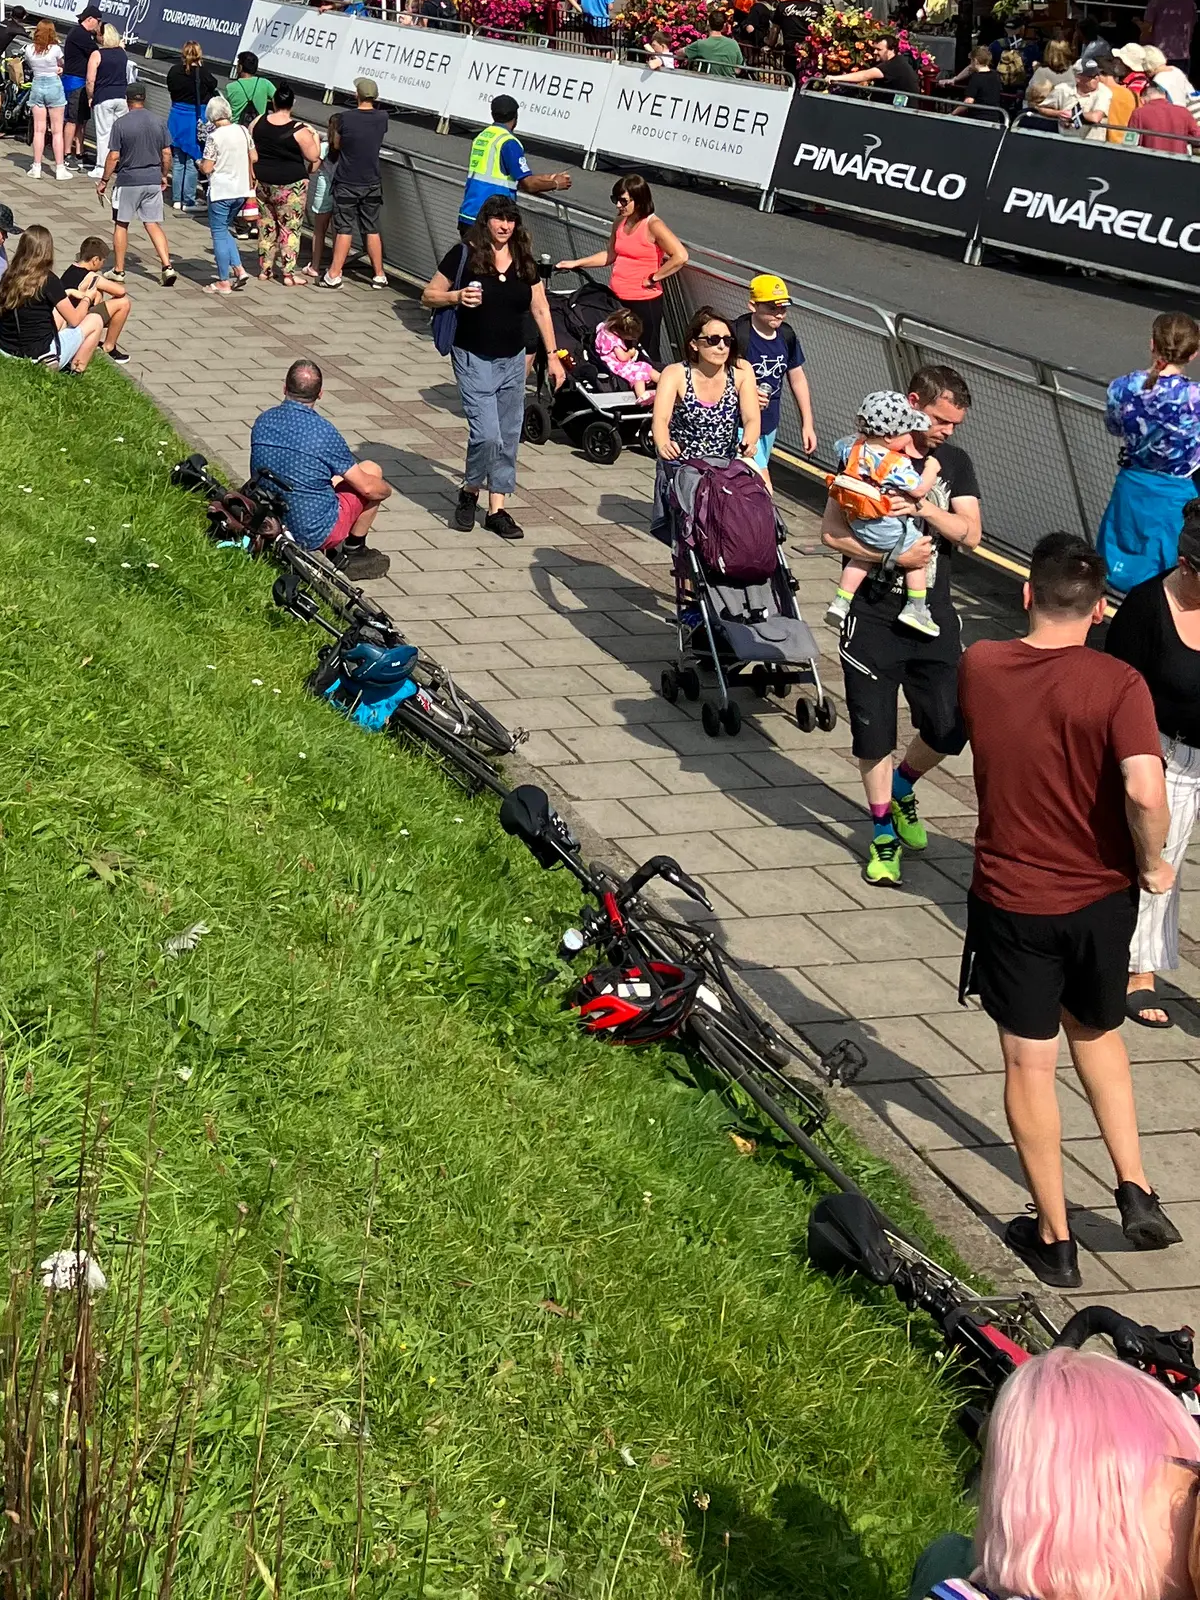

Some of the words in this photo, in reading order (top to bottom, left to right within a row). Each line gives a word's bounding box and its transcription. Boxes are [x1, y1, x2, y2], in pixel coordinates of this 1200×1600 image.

[99, 0, 131, 17] BRITAIN
[162, 8, 242, 37] TOUROFBRITAIN.CO.UK
[252, 16, 338, 51] NYETIMBER
[258, 43, 285, 57] PRODUCT
[292, 51, 320, 64] ENGLAND
[350, 37, 452, 75] NYETIMBER
[357, 66, 390, 81] PRODUCT
[398, 74, 432, 90] ENGLAND
[467, 59, 595, 103] NYETIMBER
[529, 104, 571, 121] ENGLAND
[616, 88, 770, 137] NYETIMBER
[631, 123, 679, 142] PRODUCT
[694, 136, 744, 155] ENGLAND
